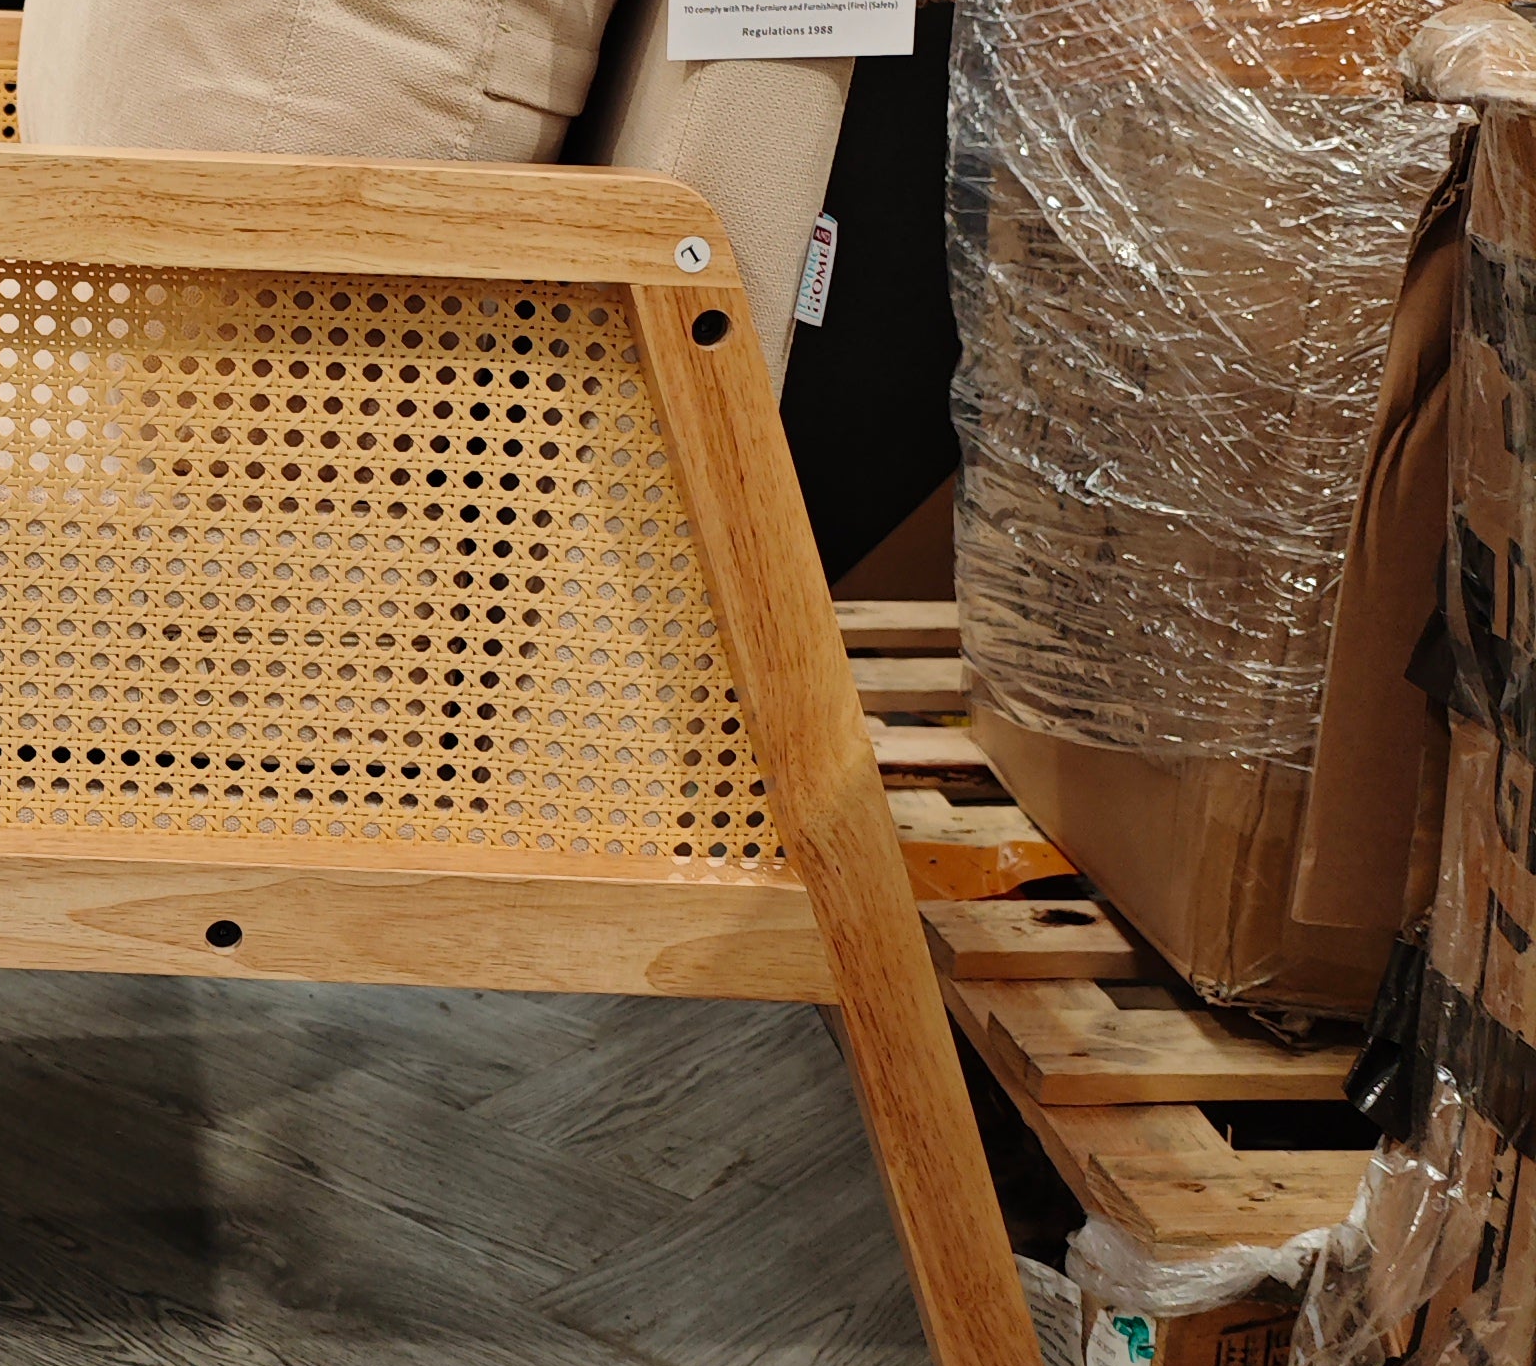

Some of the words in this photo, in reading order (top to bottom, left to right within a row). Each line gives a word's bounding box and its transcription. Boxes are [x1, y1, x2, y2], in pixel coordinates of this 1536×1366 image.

[695, 5, 722, 16] comply
[723, 4, 740, 14] with
[741, 4, 755, 13] The
[789, 2, 803, 12] and
[742, 25, 805, 39] Regulations
[808, 25, 833, 36] 1988
